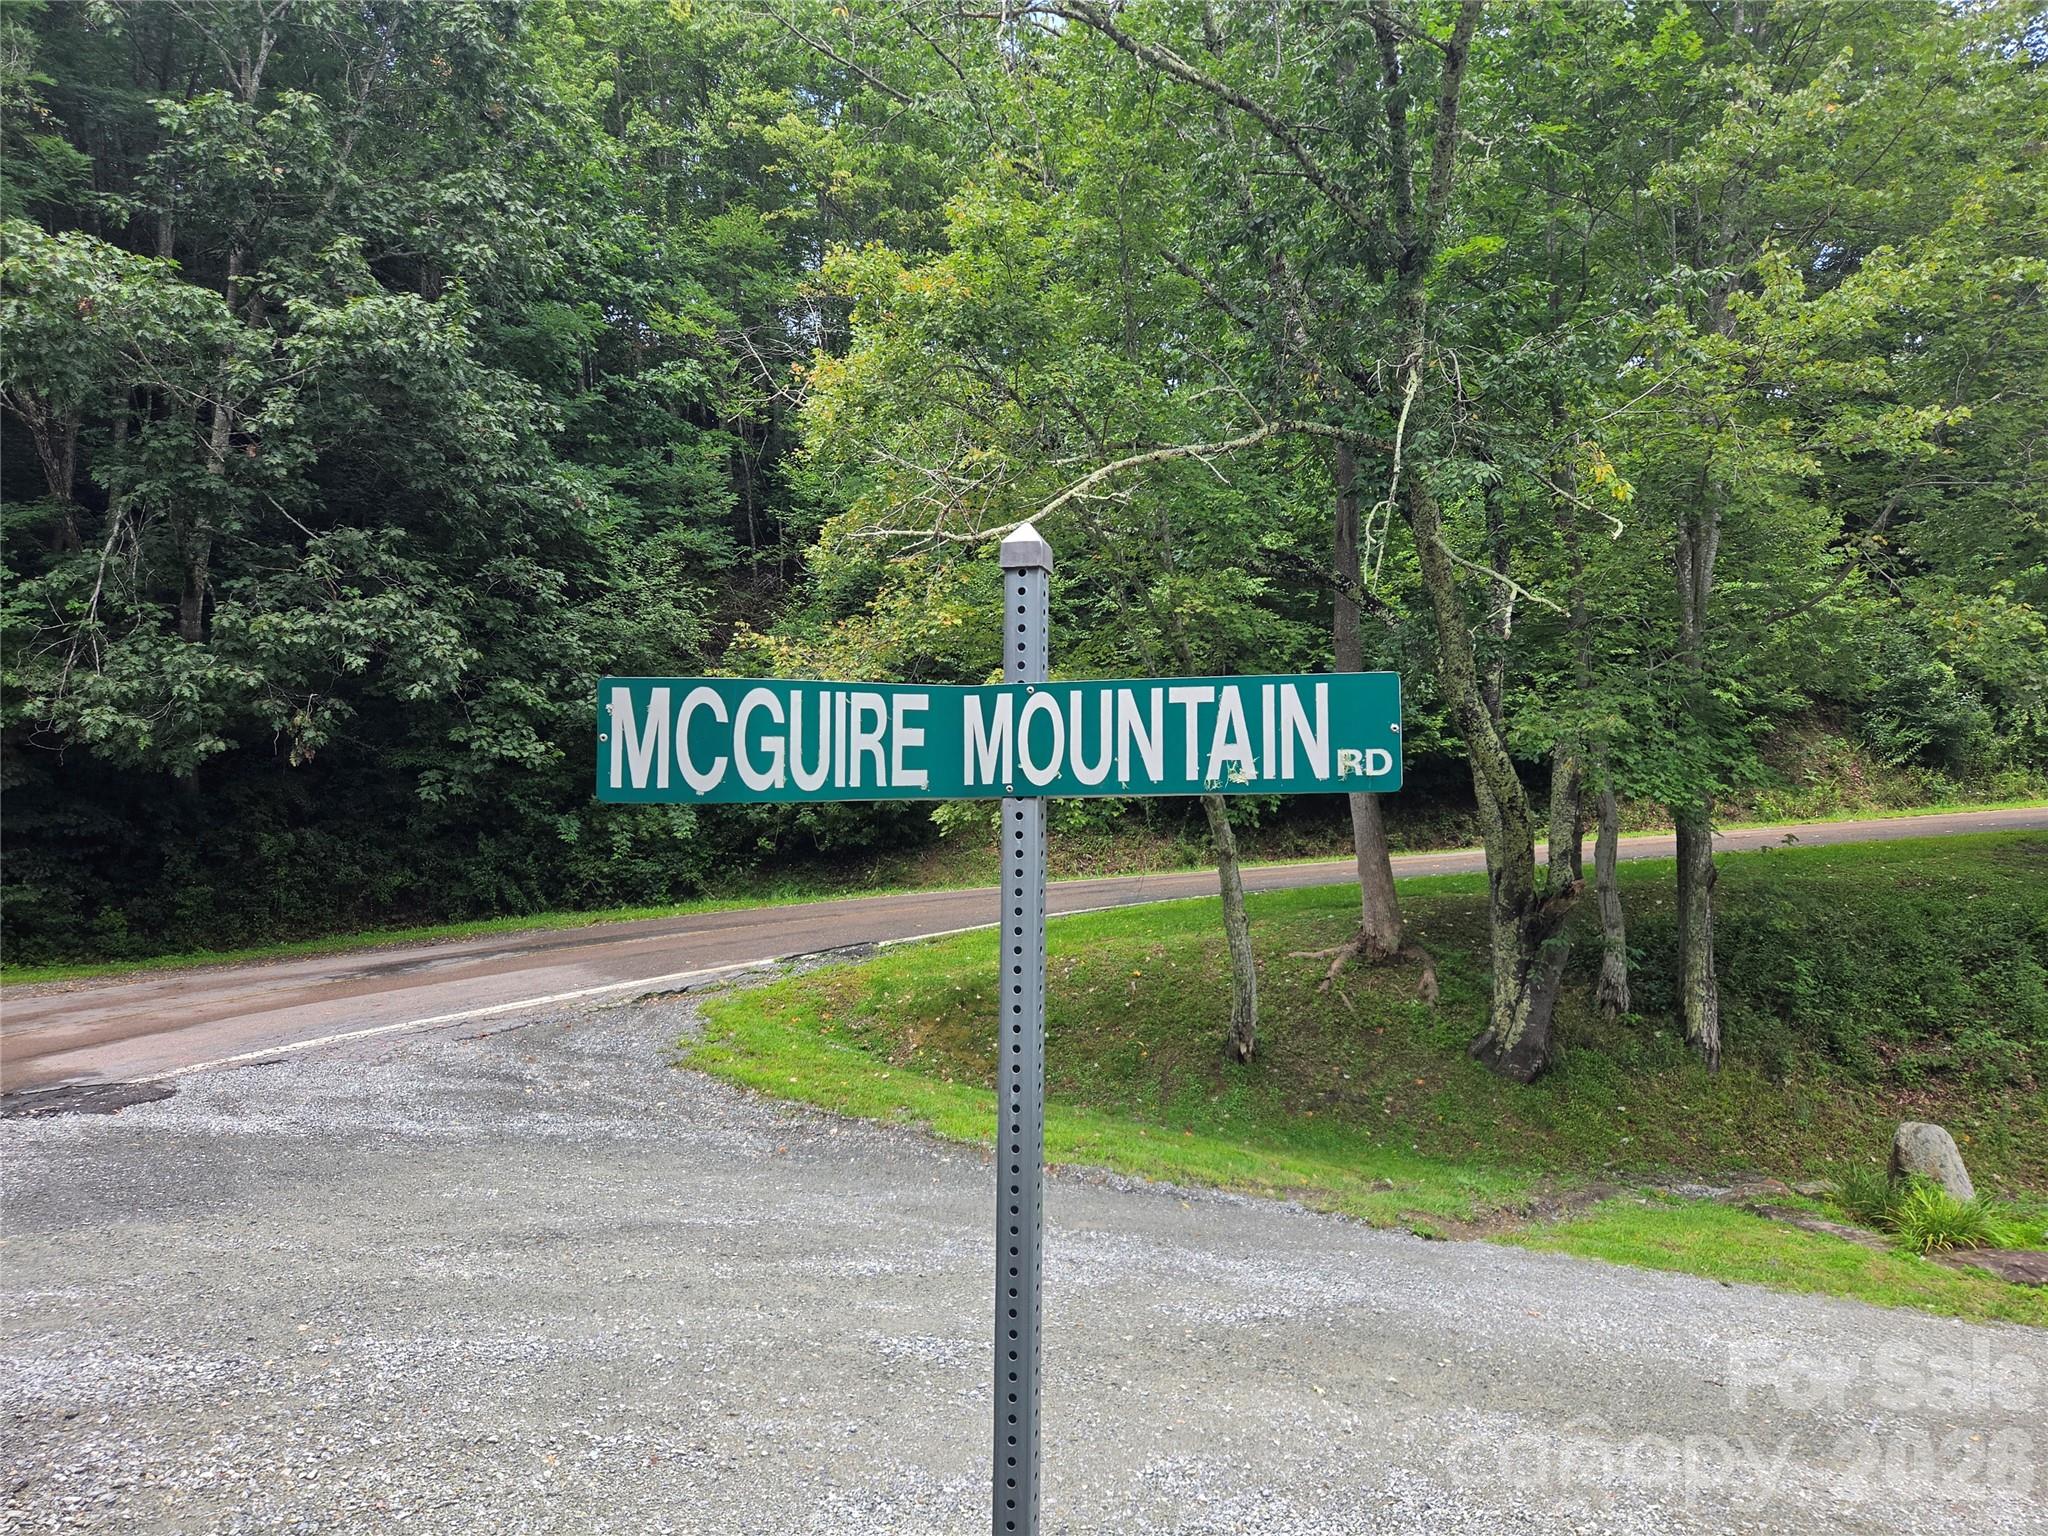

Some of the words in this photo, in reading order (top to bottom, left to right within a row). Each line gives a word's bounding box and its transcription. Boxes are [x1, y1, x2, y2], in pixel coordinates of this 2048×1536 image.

[609, 686, 929, 792] MCGUIRE
[963, 682, 1330, 788] MOUNTAIN
[1336, 747, 1394, 777] RD
